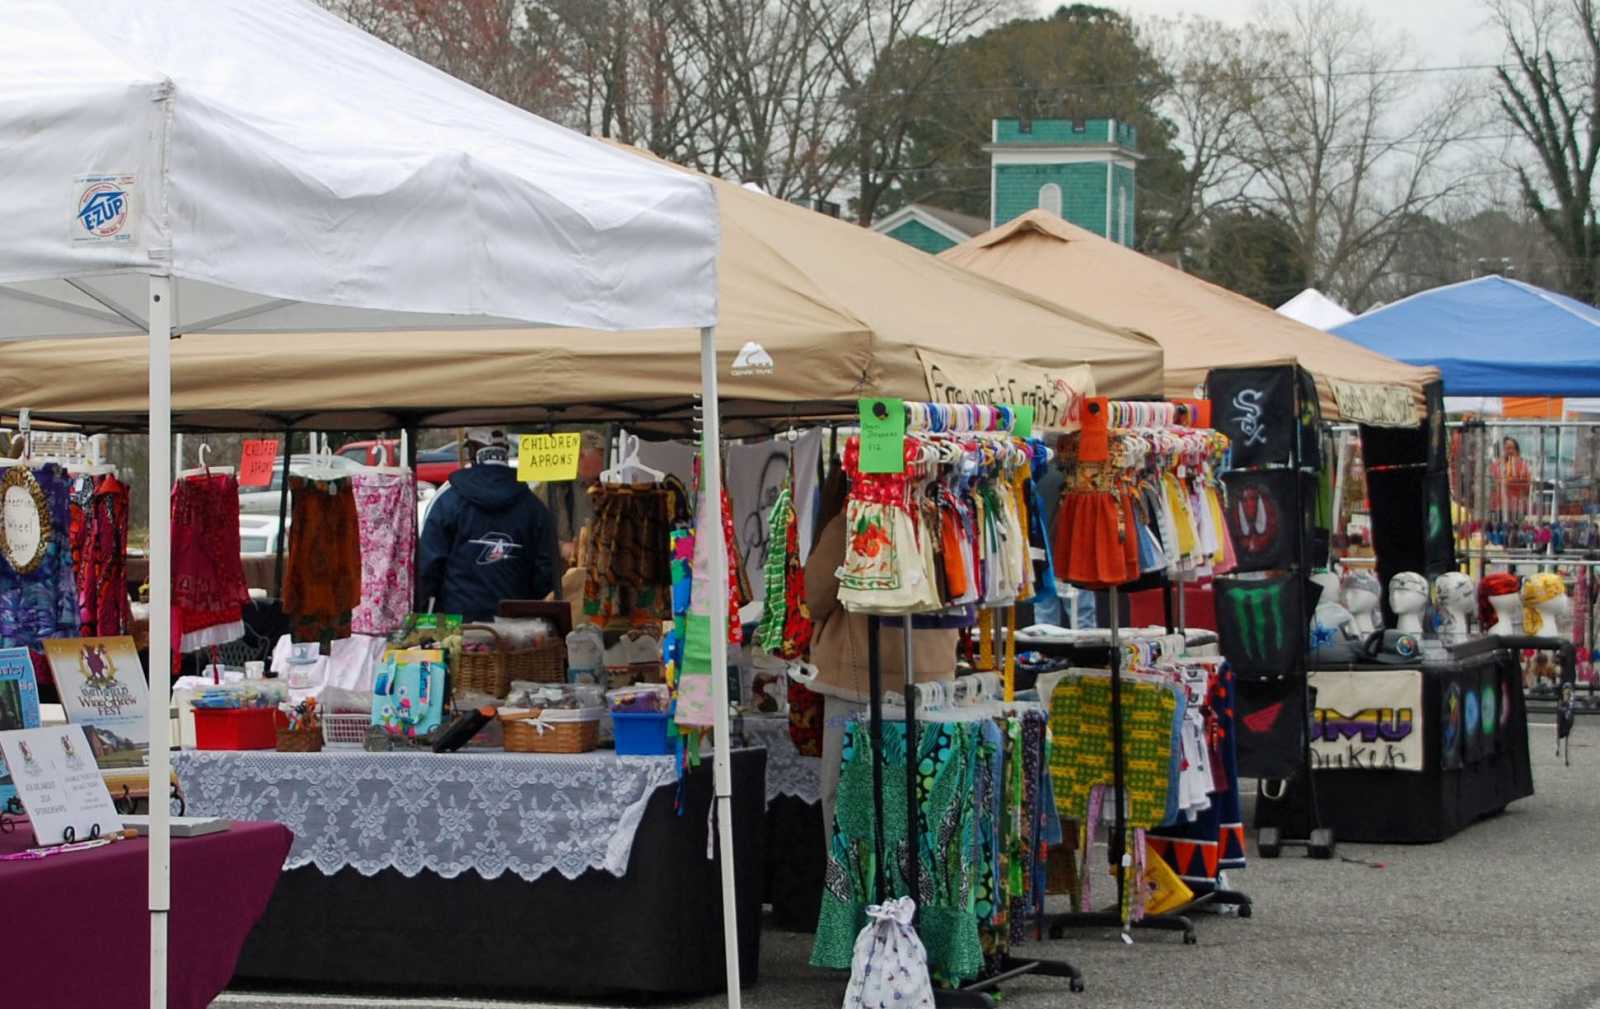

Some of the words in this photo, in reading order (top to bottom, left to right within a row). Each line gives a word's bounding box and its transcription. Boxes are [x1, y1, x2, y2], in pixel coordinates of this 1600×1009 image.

[521, 436, 578, 450] CHILDREN
[530, 453, 573, 469] APRONS
[98, 705, 121, 716] FEST
